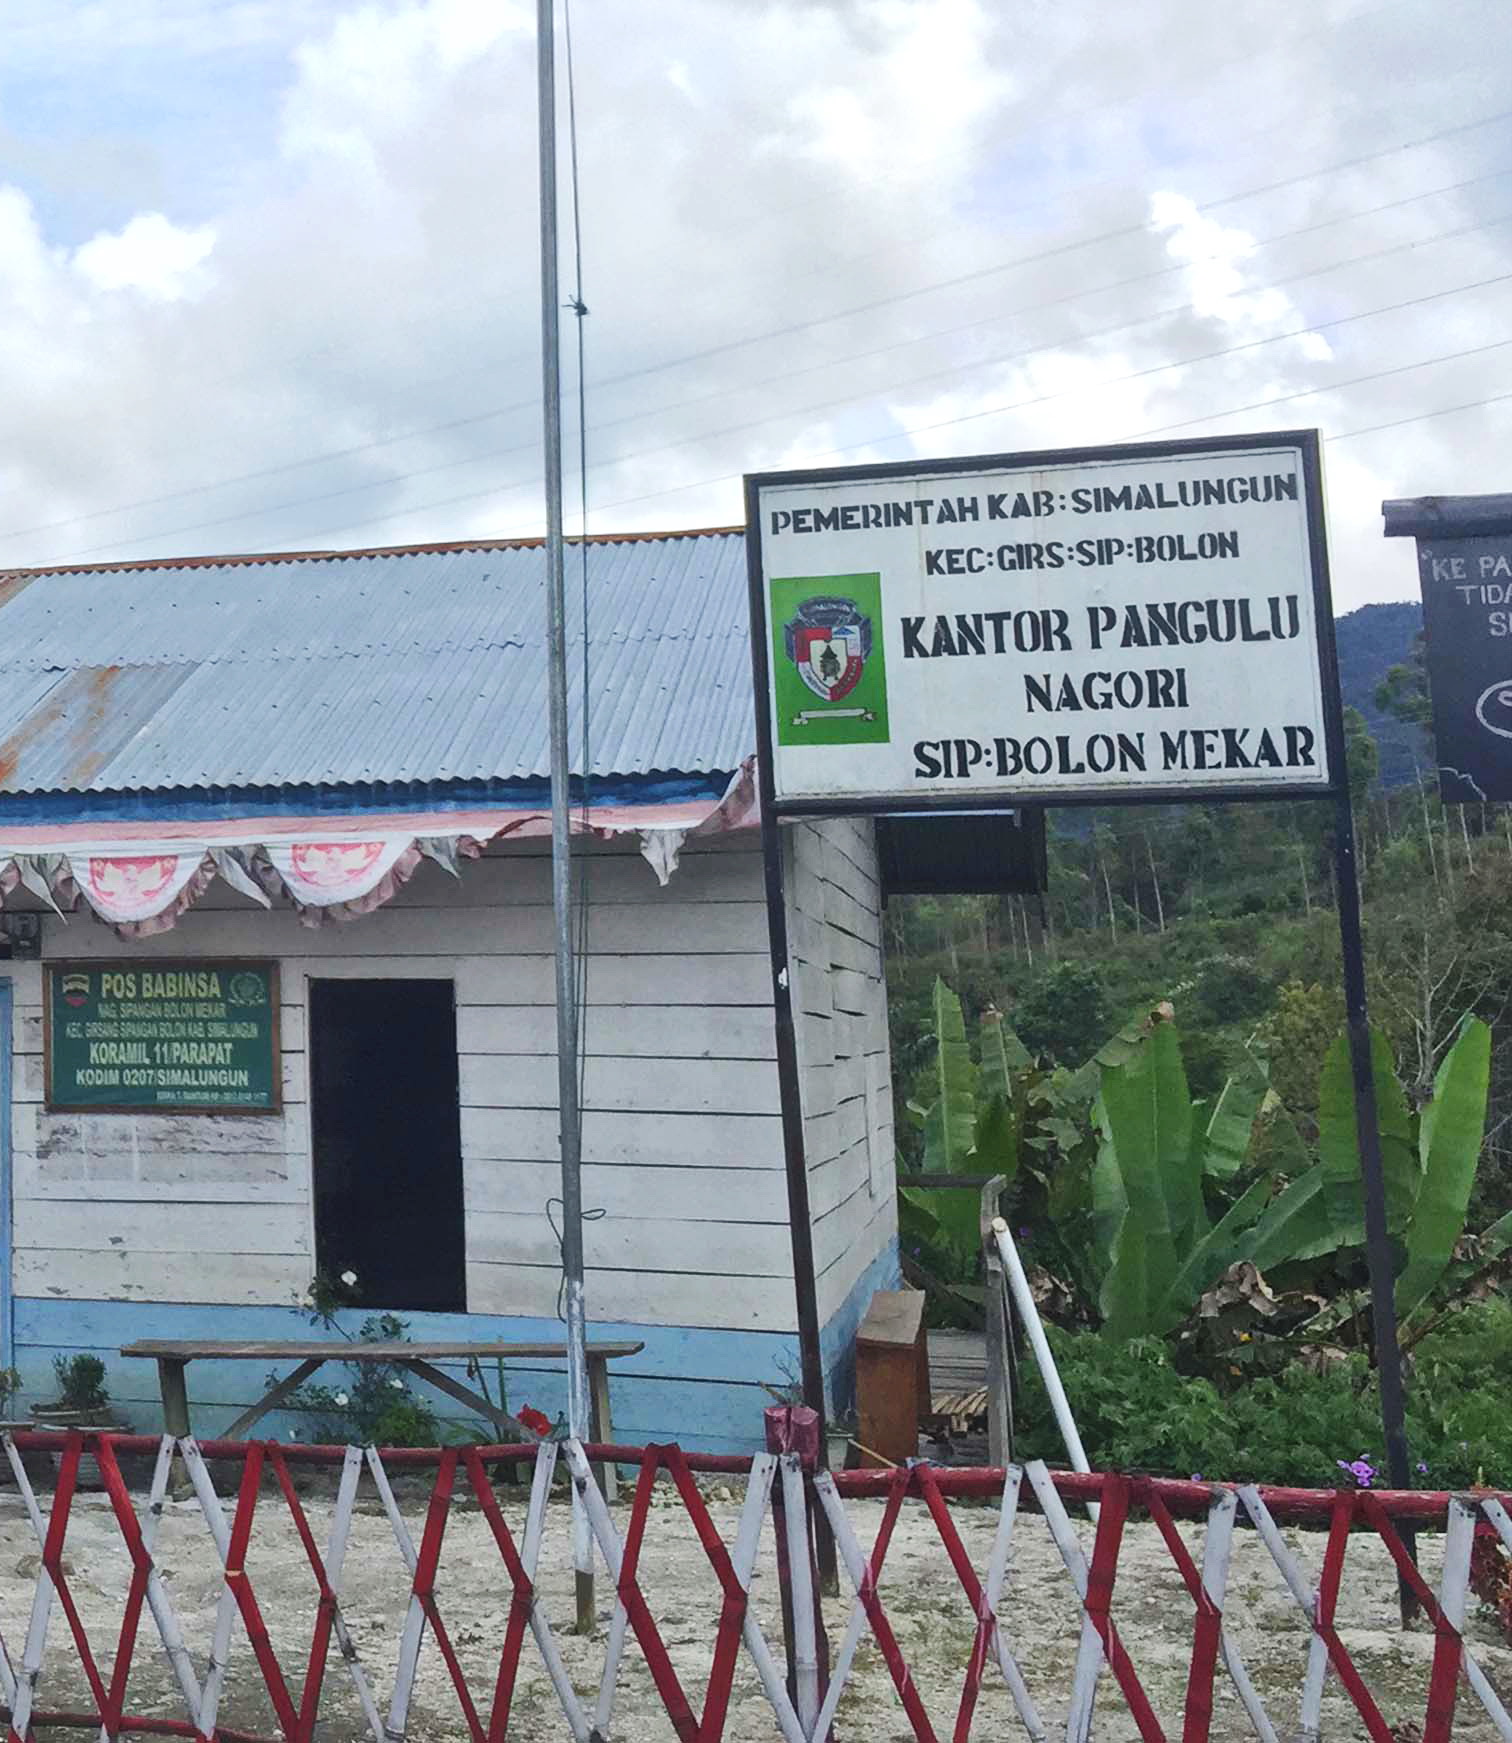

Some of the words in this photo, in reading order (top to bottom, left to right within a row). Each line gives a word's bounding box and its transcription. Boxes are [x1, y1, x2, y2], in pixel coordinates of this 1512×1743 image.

[771, 496, 980, 535] PEMERINTAH
[900, 607, 1072, 659] KANTOR
[1086, 595, 1301, 650] PANGULU
[1024, 667, 1190, 713] NAGORI
[1161, 726, 1316, 772] MEKAR
[101, 973, 136, 998] POS
[142, 972, 221, 998] BABINSA
[89, 1042, 150, 1065] KORAMIL
[76, 1069, 120, 1087] KODIM
